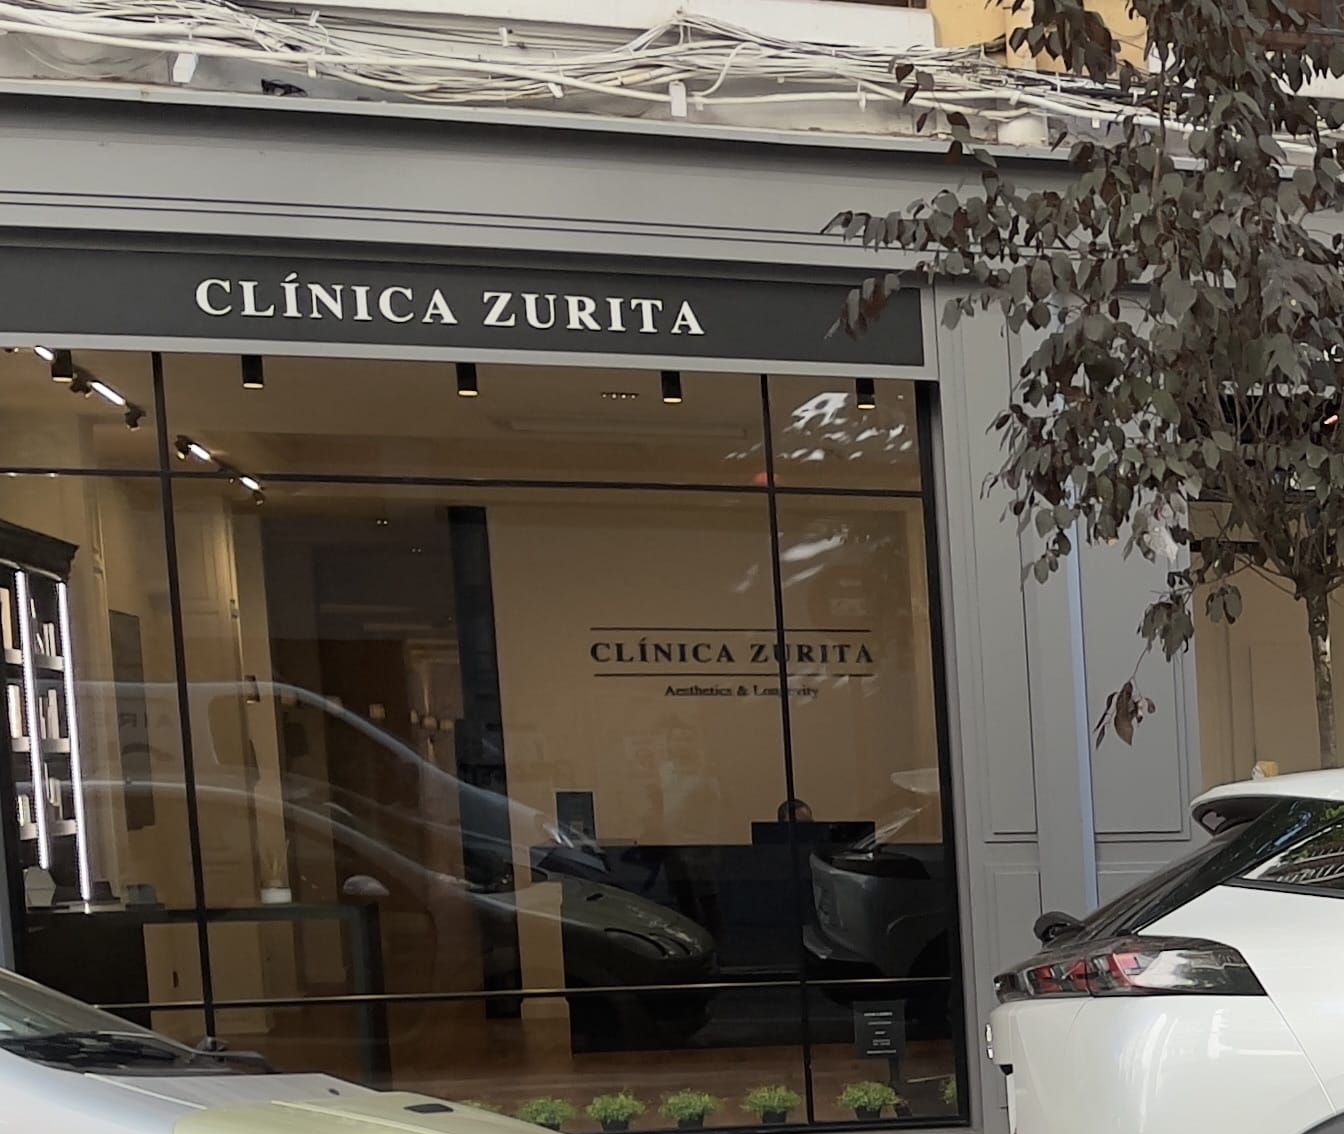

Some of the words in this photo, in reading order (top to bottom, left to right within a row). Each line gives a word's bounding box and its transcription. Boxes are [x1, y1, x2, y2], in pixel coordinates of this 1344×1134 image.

[195, 272, 459, 325] CLÍNICA
[482, 291, 705, 335] ZURITA
[589, 637, 736, 664] CLÍNICA
[750, 643, 875, 664] ZURITA
[736, 684, 749, 697] &
[753, 684, 819, 700] Lonevity
